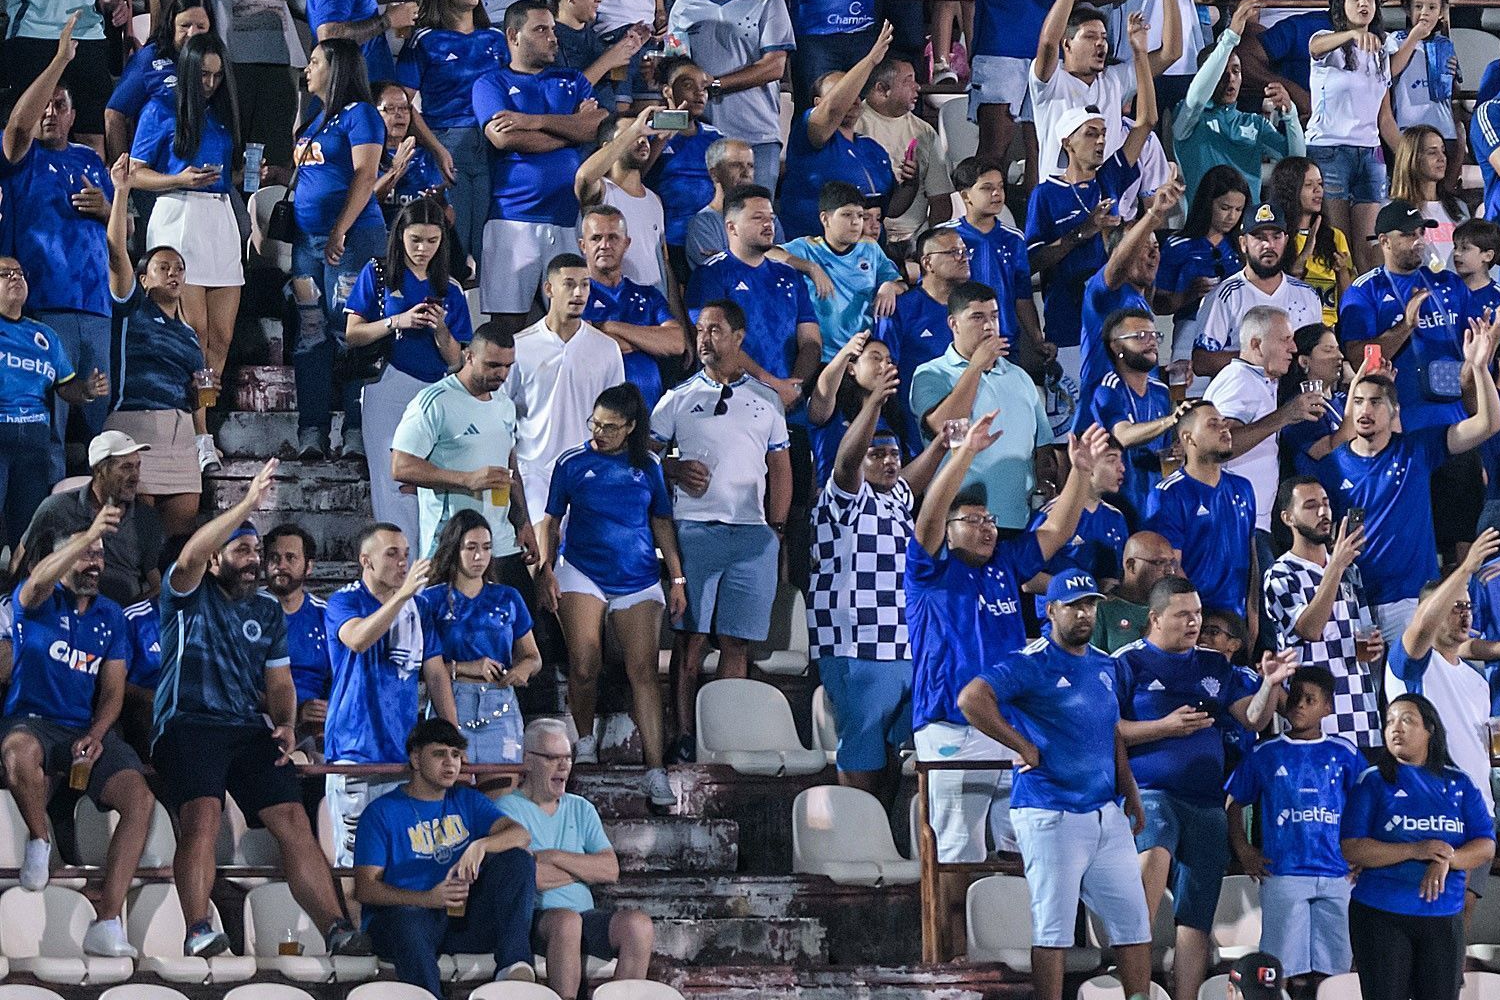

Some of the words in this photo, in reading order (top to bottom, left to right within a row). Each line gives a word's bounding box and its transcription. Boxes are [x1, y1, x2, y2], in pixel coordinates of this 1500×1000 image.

[1416, 310, 1458, 329] etfair
[7, 355, 56, 381] betfa
[1065, 576, 1094, 590] NYC
[1291, 807, 1340, 825] betfair
[1403, 815, 1466, 834] betfair
